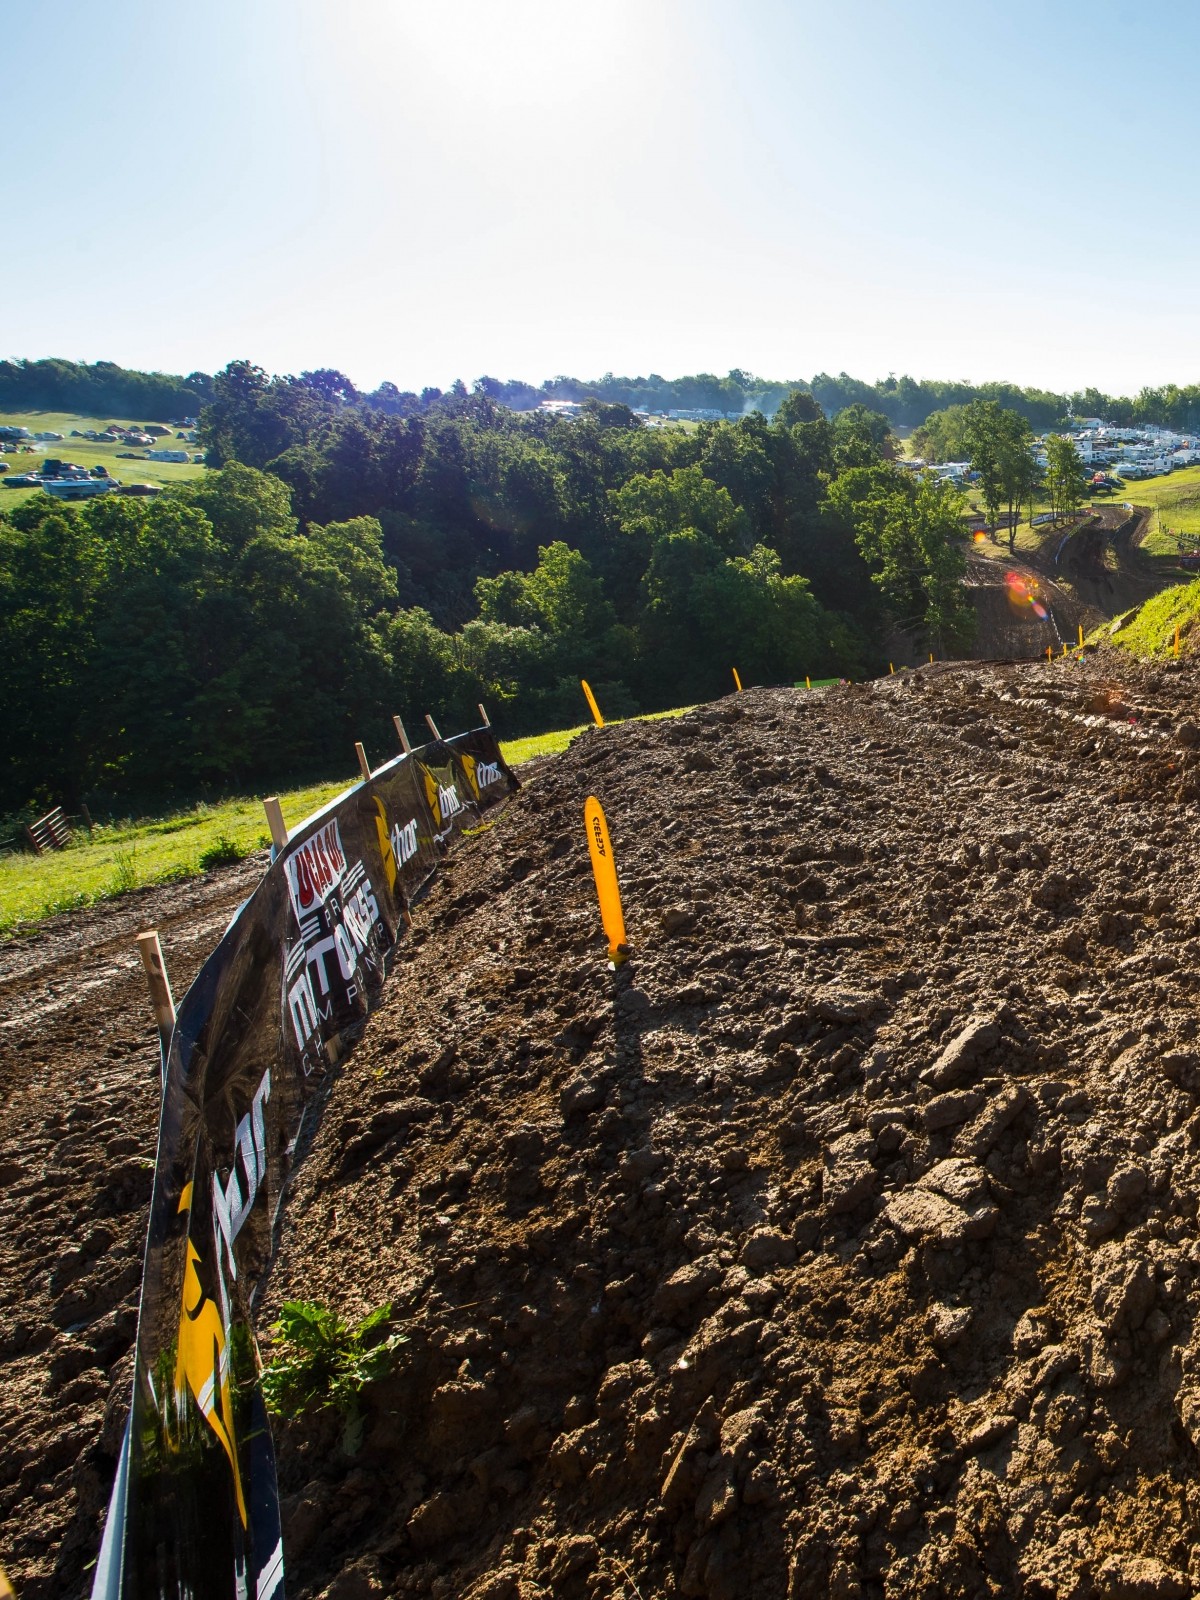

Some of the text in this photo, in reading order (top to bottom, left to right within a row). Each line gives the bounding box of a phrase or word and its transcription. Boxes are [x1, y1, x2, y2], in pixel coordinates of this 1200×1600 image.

[438, 784, 460, 819] thor
[391, 818, 417, 870] thor
[289, 834, 333, 908] UCAS
